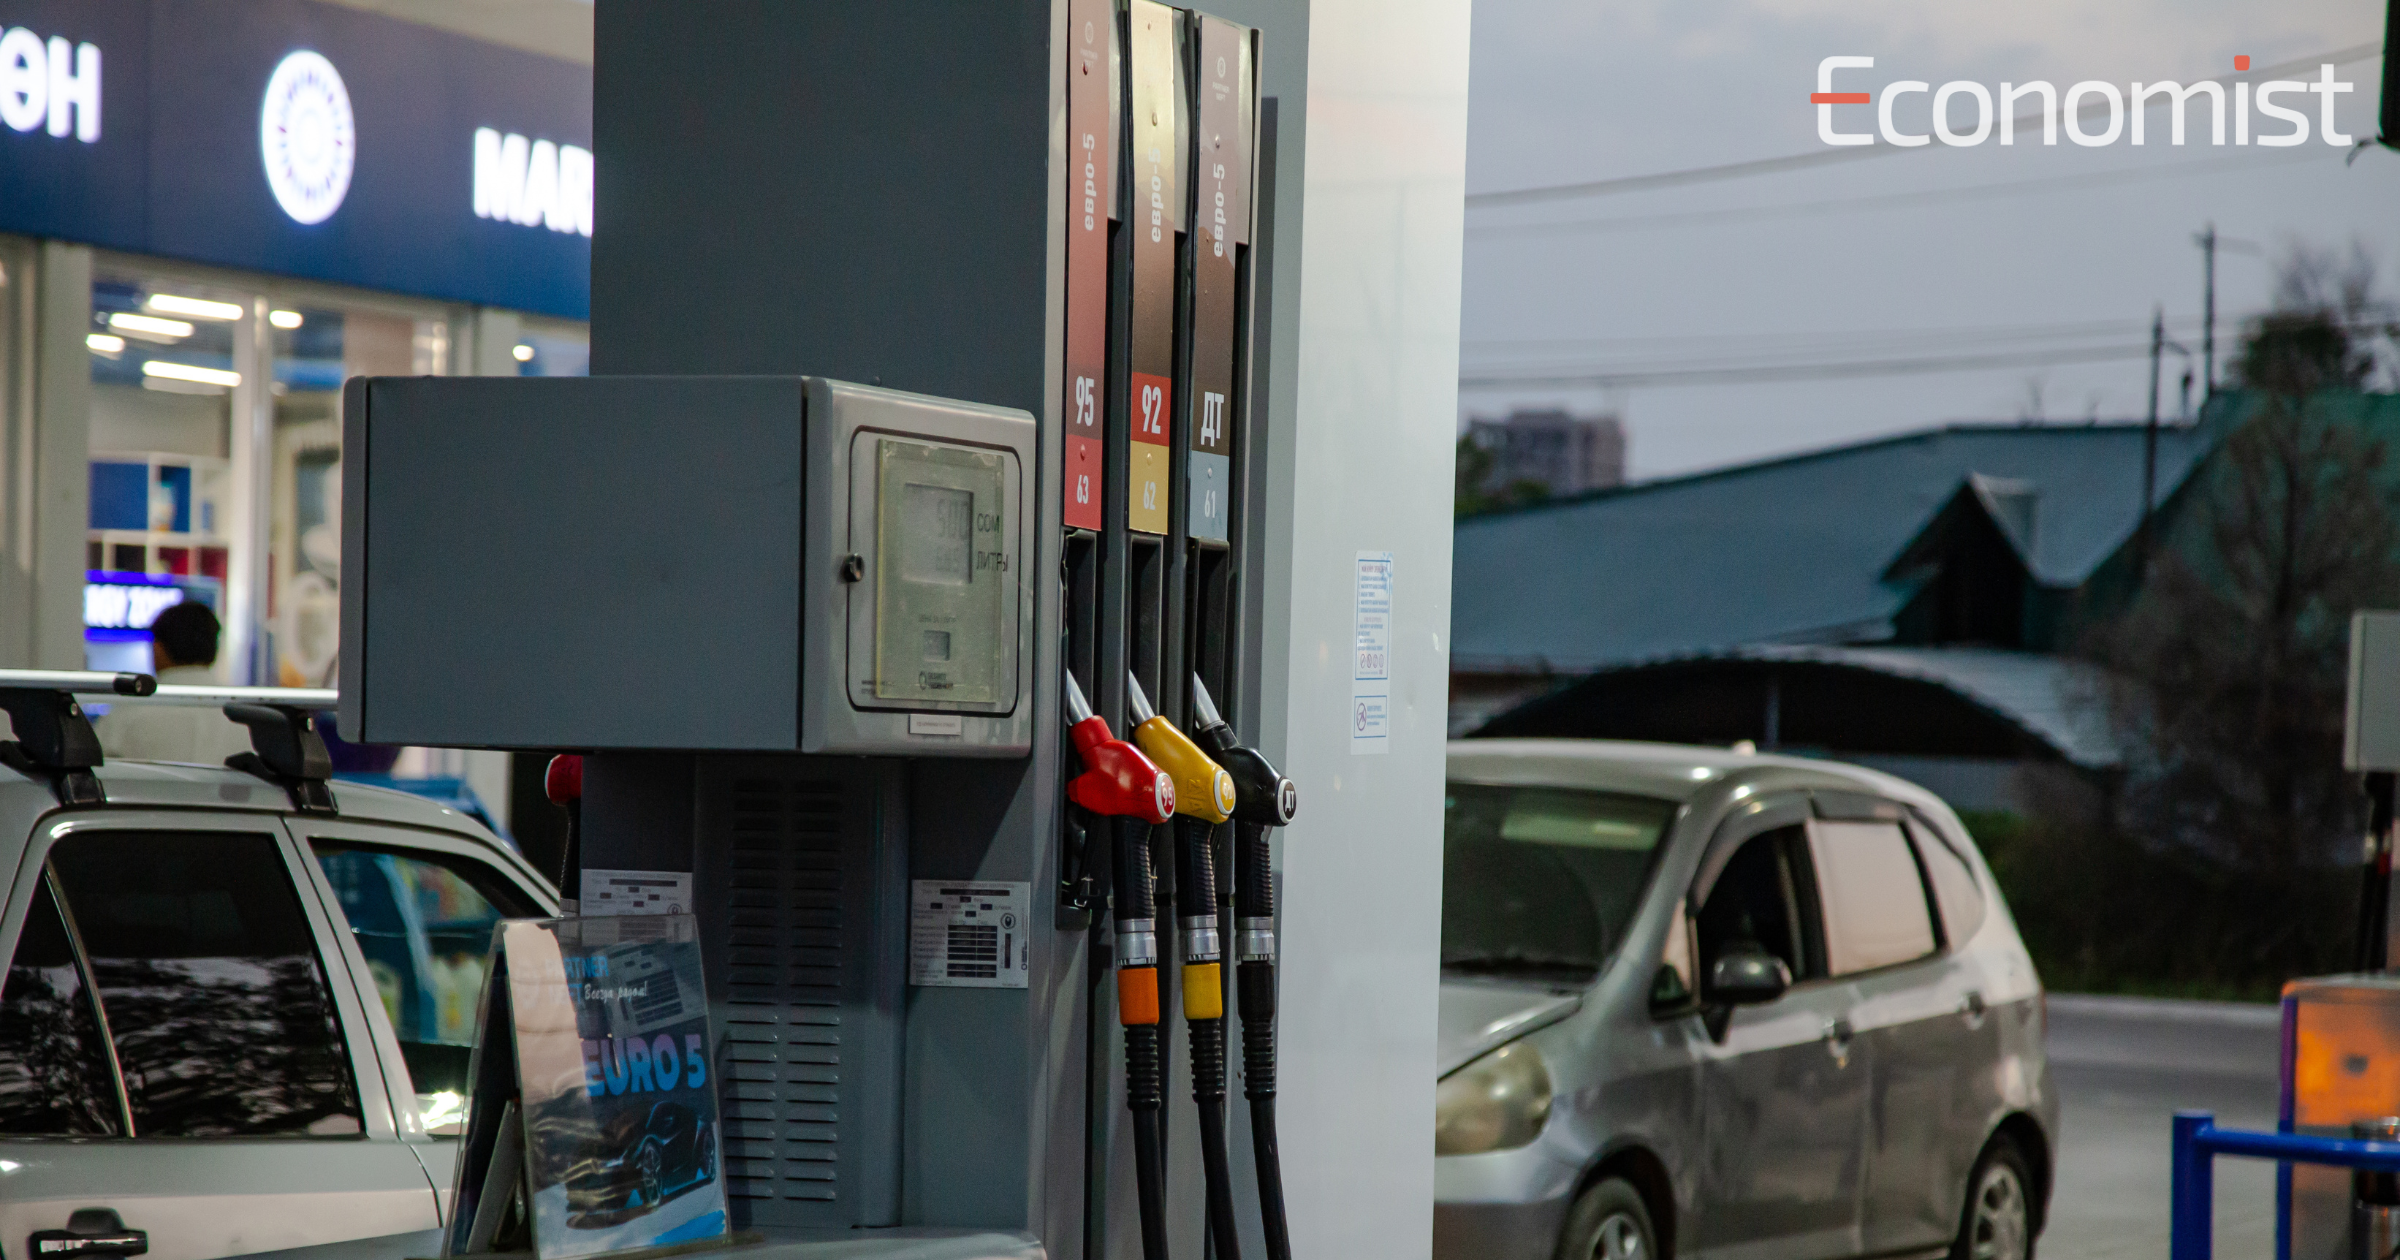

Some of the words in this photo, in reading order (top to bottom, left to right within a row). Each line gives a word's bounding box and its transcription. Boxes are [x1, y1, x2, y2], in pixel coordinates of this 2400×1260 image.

[0, 25, 102, 143] ӨН
[1075, 375, 1095, 427] 95
[1141, 384, 1162, 435] 92
[1200, 391, 1225, 447] ДТ
[1076, 475, 1089, 504] 63
[1143, 480, 1156, 510] 62
[1204, 490, 1216, 518] 61
[976, 551, 1008, 572] ЛИТРЫ
[1161, 786, 1173, 807] 95
[1222, 781, 1234, 802] 92
[581, 1034, 680, 1098] EURO
[685, 1033, 707, 1090] 5
